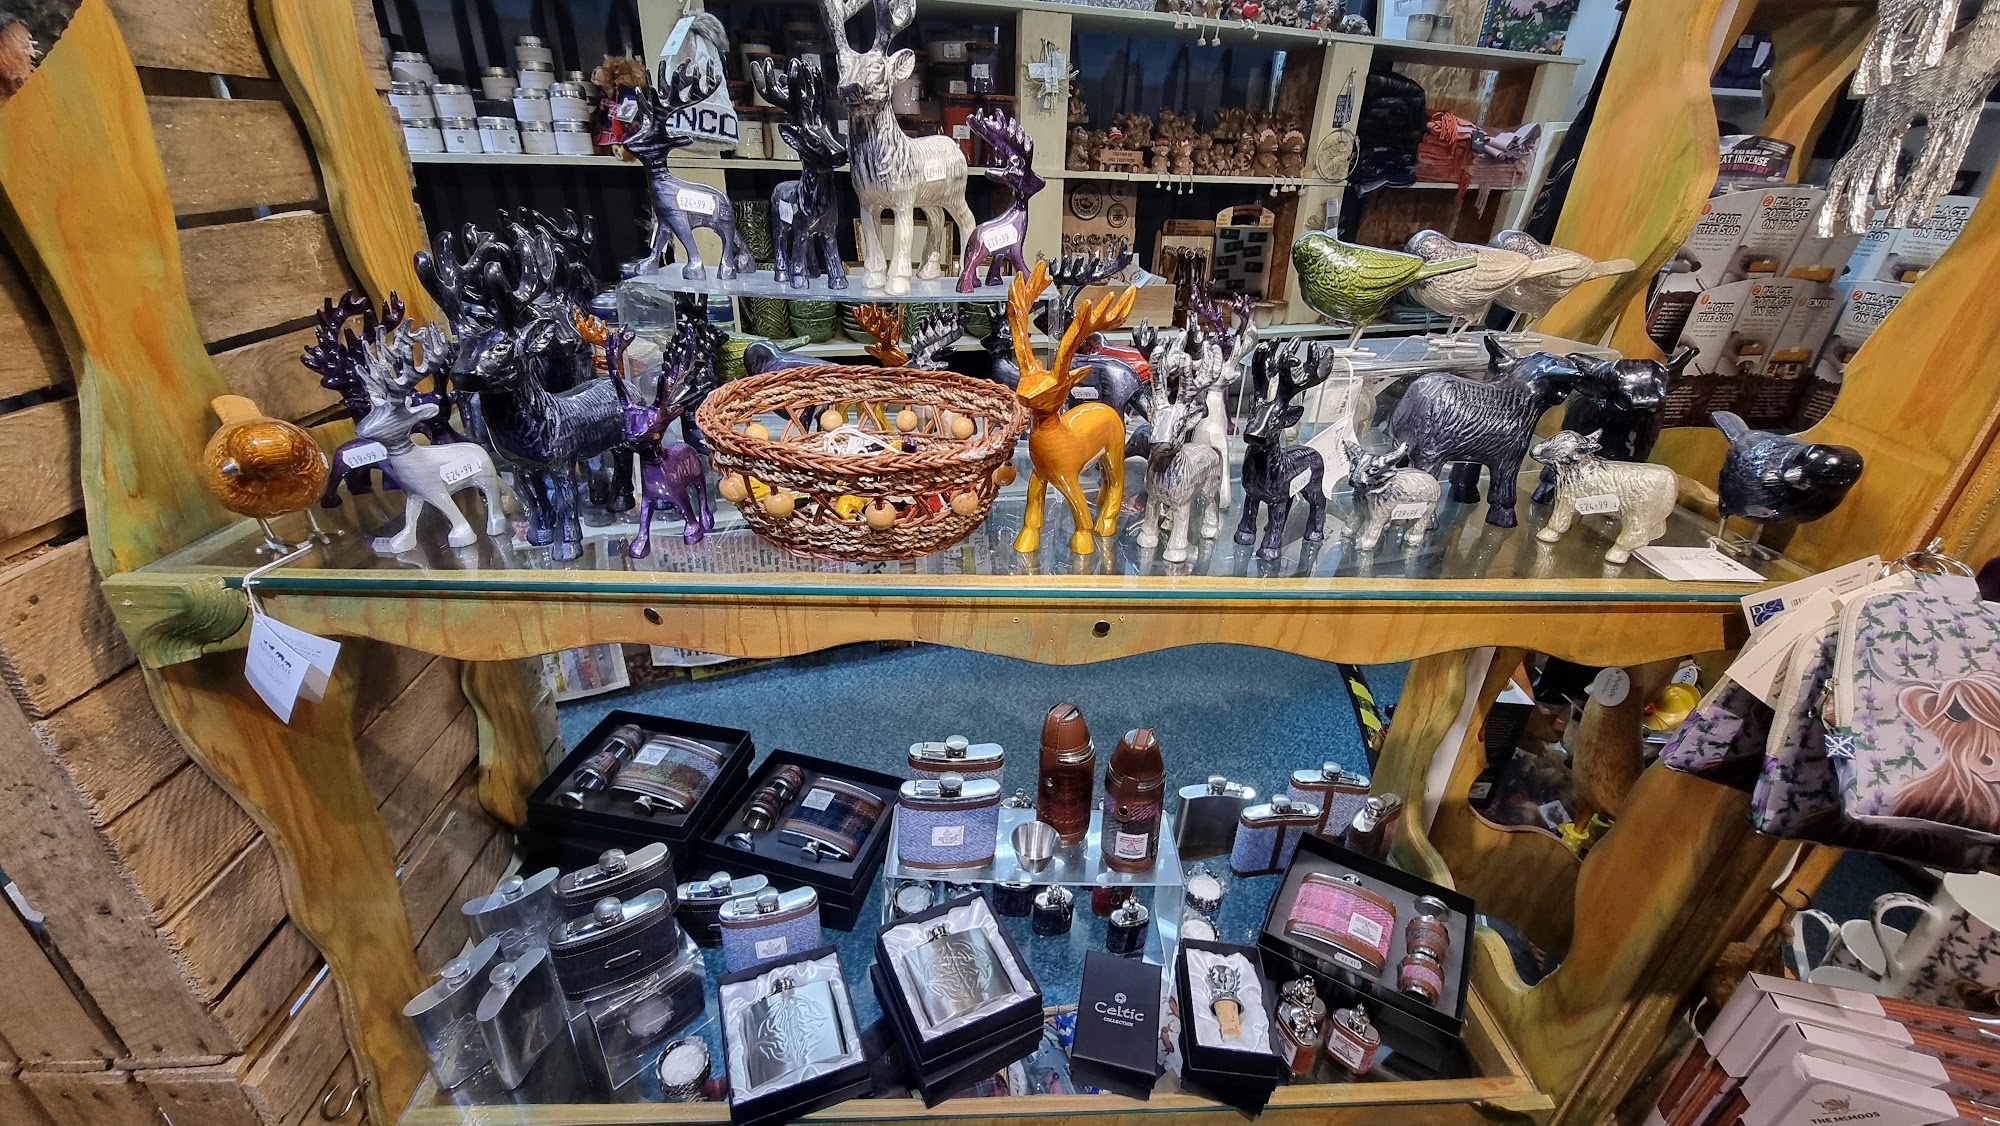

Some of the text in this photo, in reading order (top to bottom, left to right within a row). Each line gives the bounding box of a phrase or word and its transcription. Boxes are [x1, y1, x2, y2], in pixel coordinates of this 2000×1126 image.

[1734, 154, 1770, 167] INCENSE
[1774, 197, 1810, 208] PLACE
[1762, 208, 1810, 219] COTTAGE
[1933, 205, 1969, 218] LACE
[1706, 213, 1742, 224] LIGHT
[1697, 224, 1741, 235] THE SOD
[1762, 219, 1799, 230] ON TOP
[1866, 231, 1890, 242] SOD
[1913, 228, 1959, 240] ON TOP
[1761, 286, 1792, 296] PLACE
[1705, 302, 1734, 312] LIGHT
[1752, 297, 1793, 306] COTTAGE
[1751, 307, 1764, 316] ON
[1852, 301, 1892, 315] COTTA
[1696, 313, 1733, 322] THE SOD
[1853, 313, 1868, 323] ON
[348, 451, 377, 466] £19.99
[445, 463, 473, 481] £24.99
[1579, 500, 1608, 511] £24.99
[1095, 1002, 1145, 1021] Celtic
[1103, 1016, 1135, 1027] COLLECTION
[1810, 1117, 1832, 1125] THE
